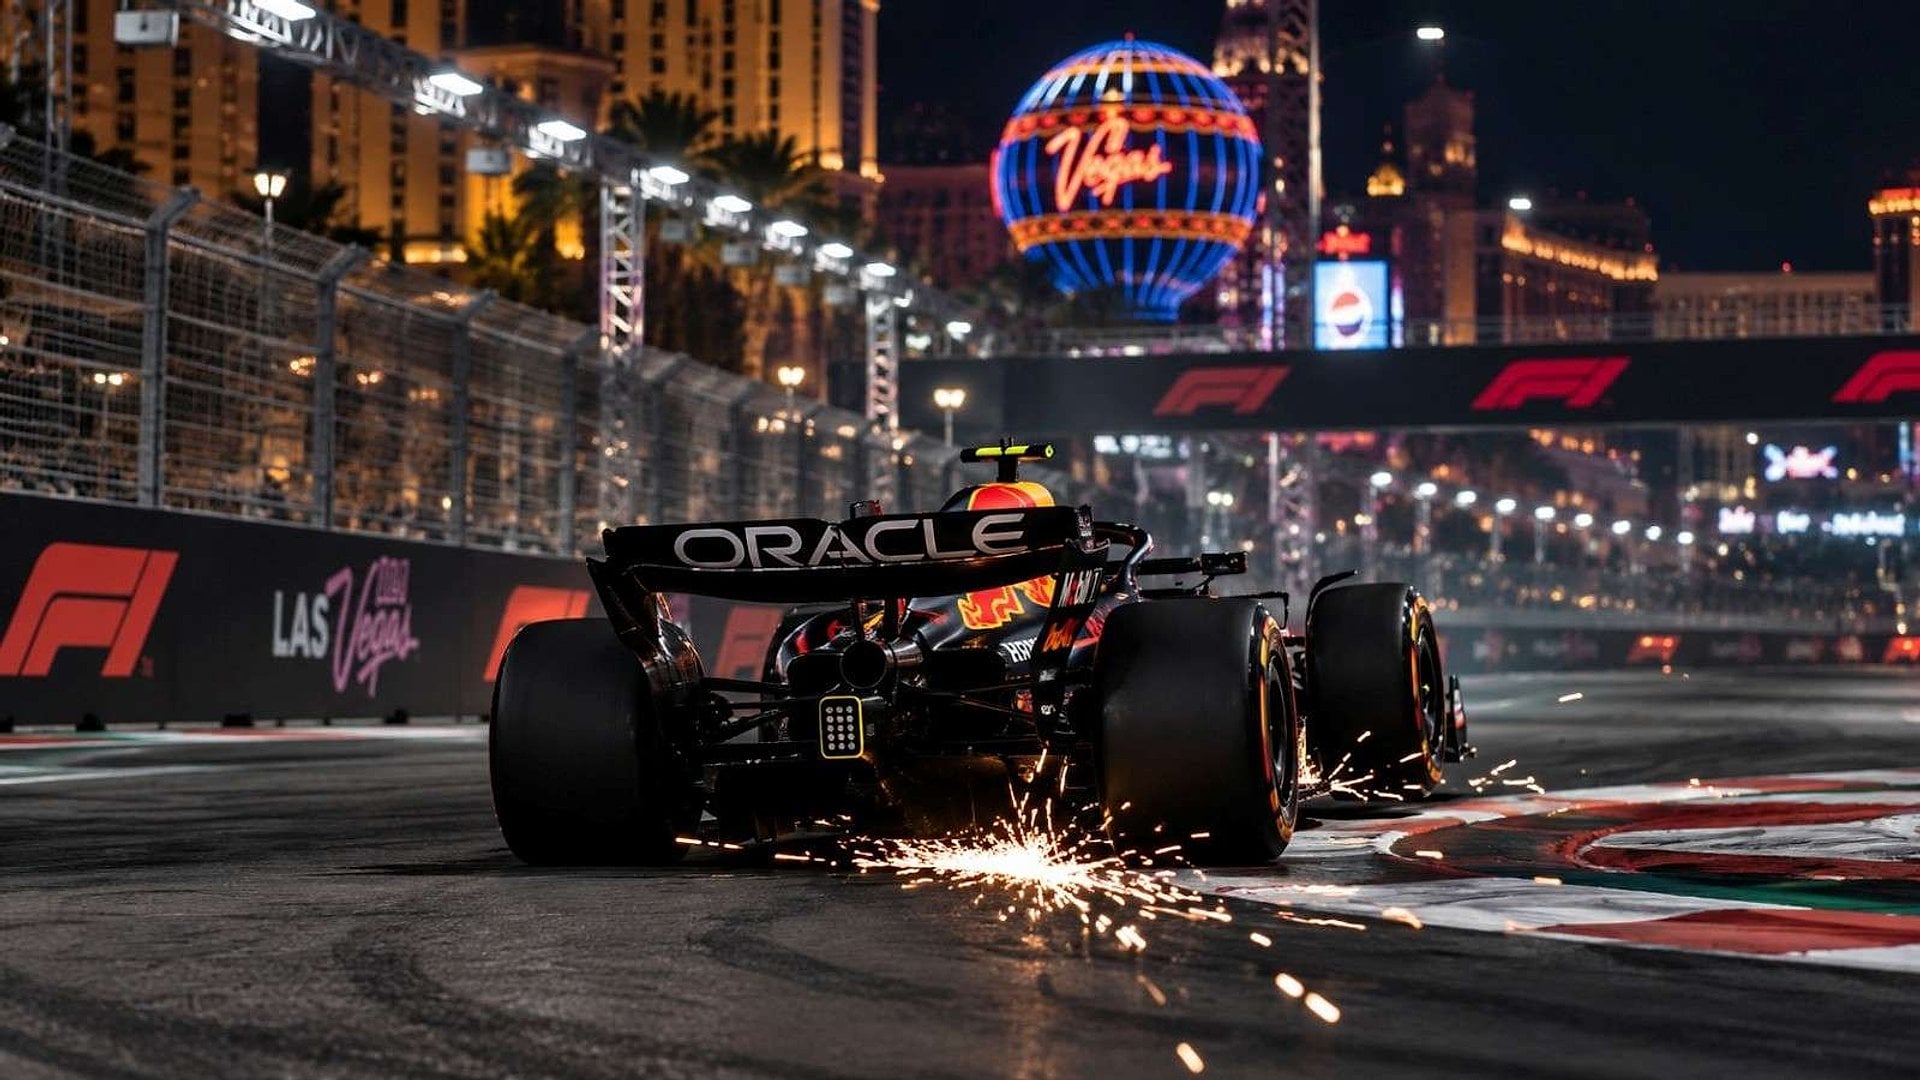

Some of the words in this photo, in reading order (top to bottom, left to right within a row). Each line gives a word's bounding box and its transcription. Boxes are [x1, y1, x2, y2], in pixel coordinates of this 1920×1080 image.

[1044, 115, 1174, 213] Vegas
[1471, 356, 1630, 410] F1
[673, 513, 1029, 568] ORACLE
[0, 541, 181, 677] F1
[272, 590, 330, 659] LAS
[325, 560, 421, 697] Vegas
